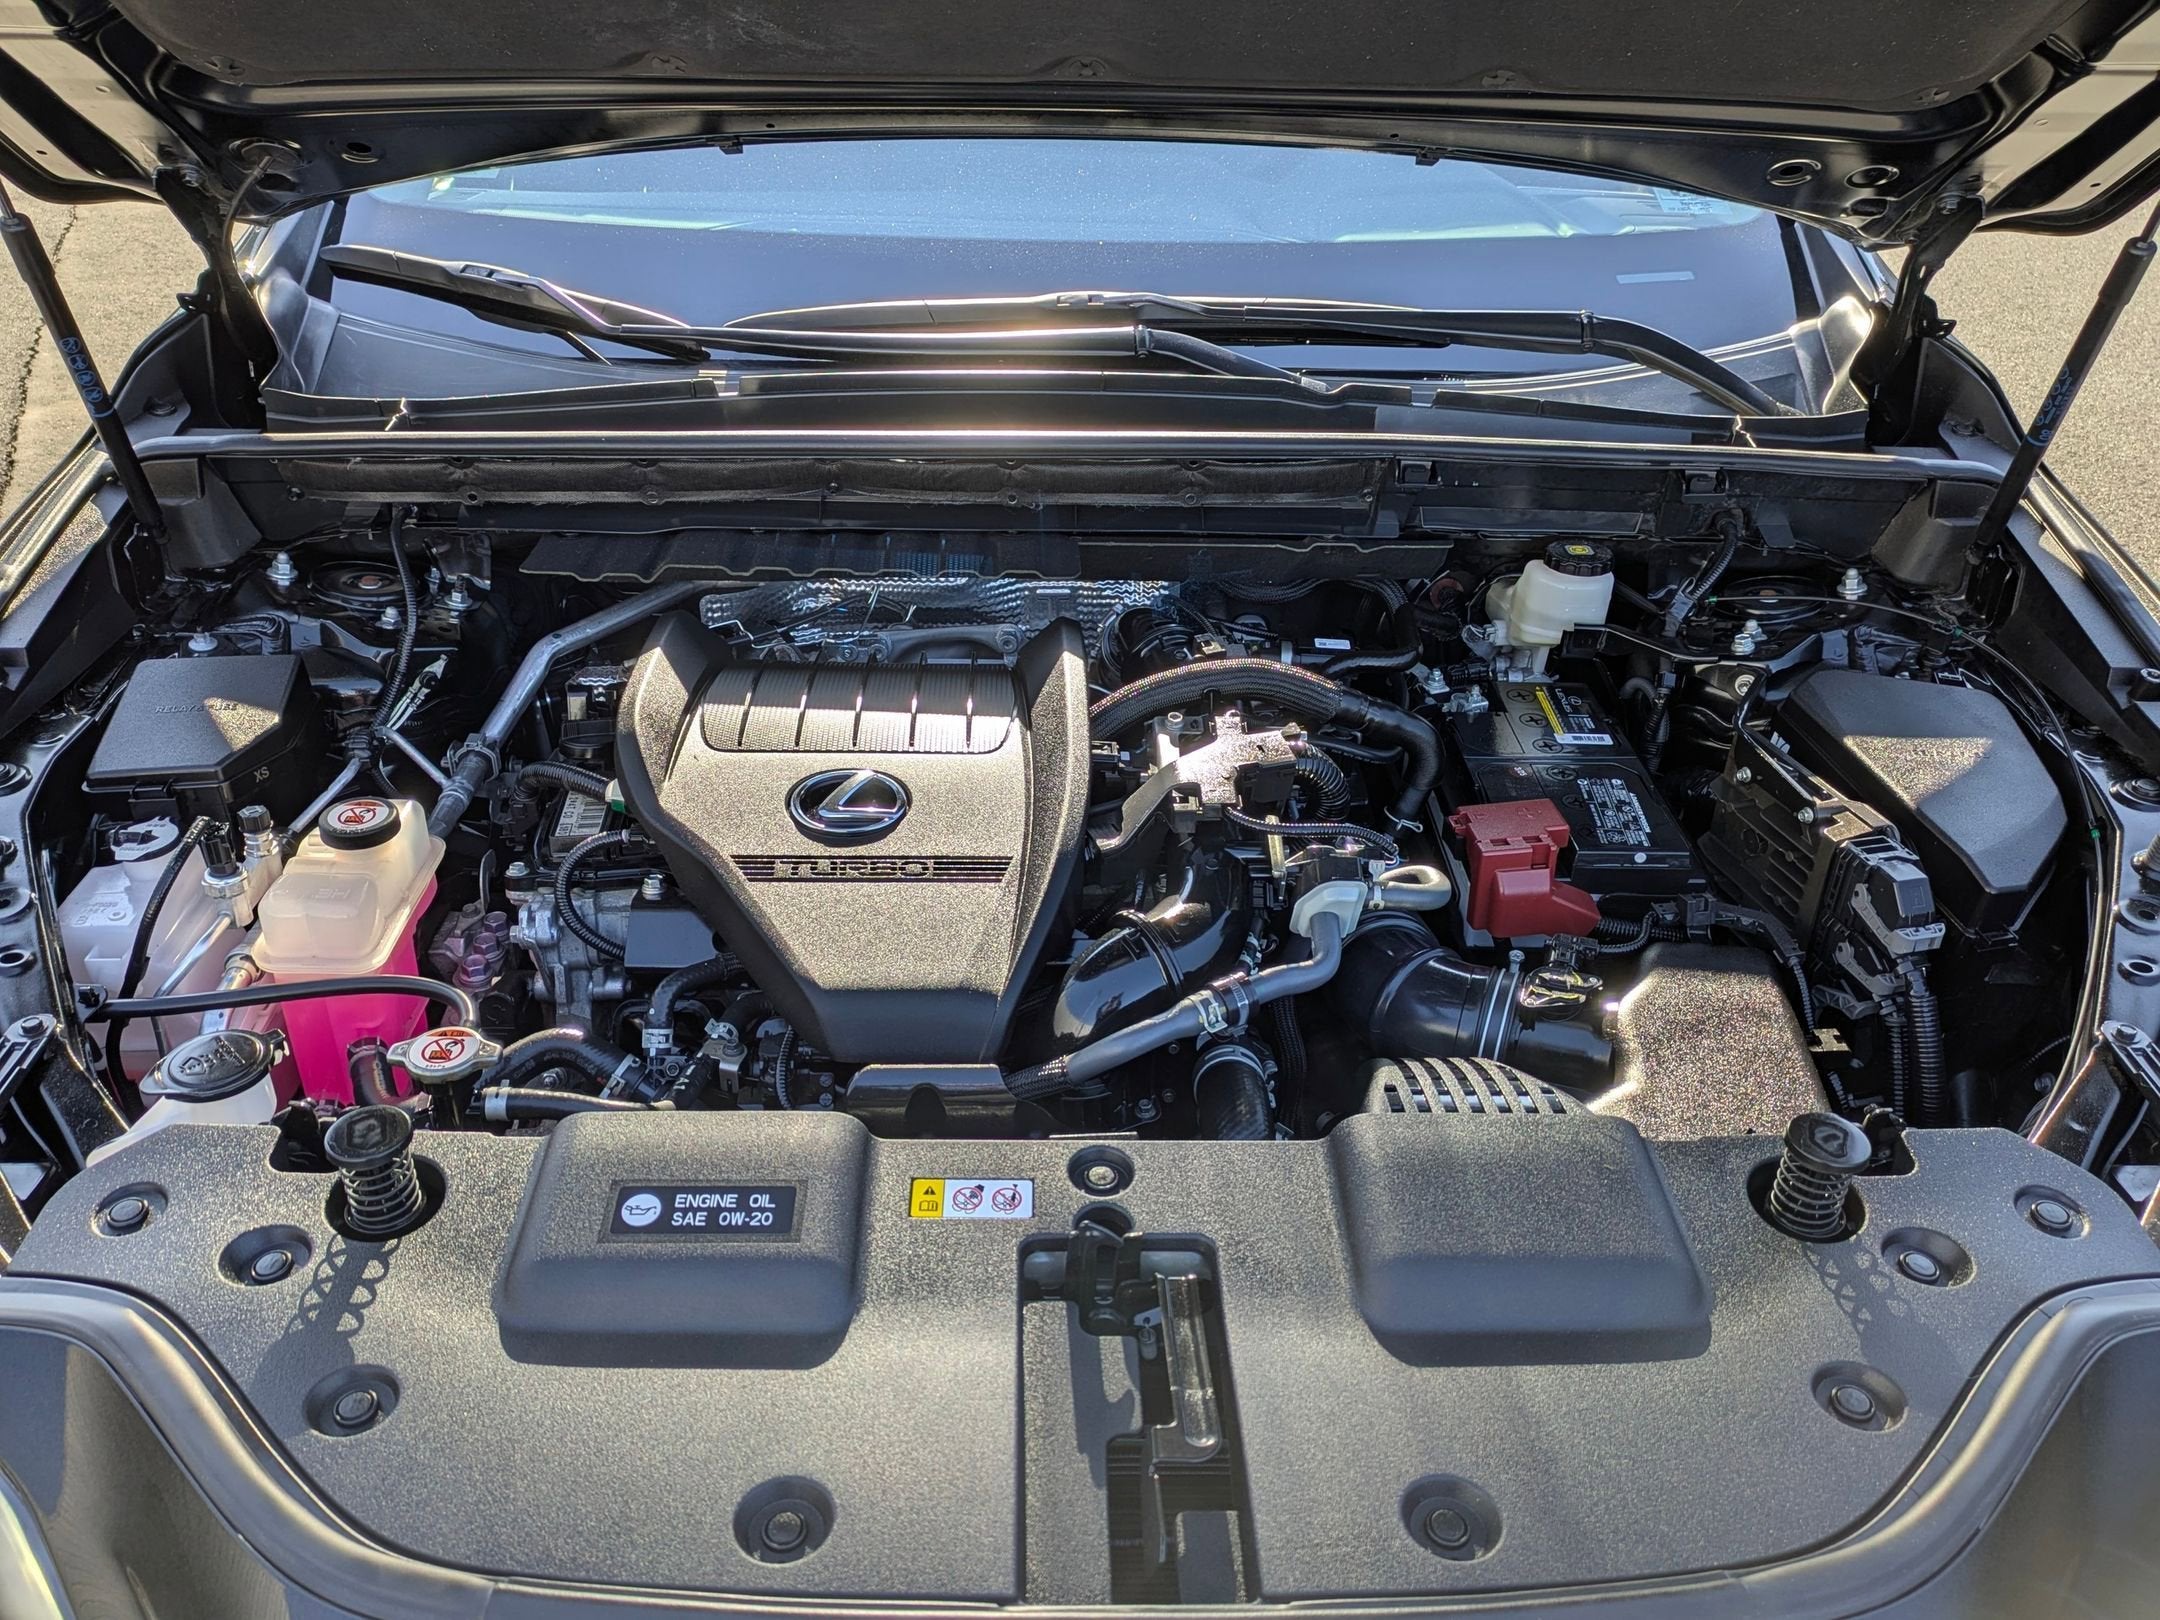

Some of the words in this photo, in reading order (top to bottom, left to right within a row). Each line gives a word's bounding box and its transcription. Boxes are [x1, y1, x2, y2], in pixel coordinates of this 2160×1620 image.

[155, 705, 195, 713] RELAY
[253, 766, 270, 783] XS
[775, 858, 934, 878] TURBO
[674, 1194, 738, 1208] ENGINE
[749, 1194, 776, 1208] OIL
[671, 1212, 708, 1226] SAE
[718, 1212, 773, 1226] 0W-20
